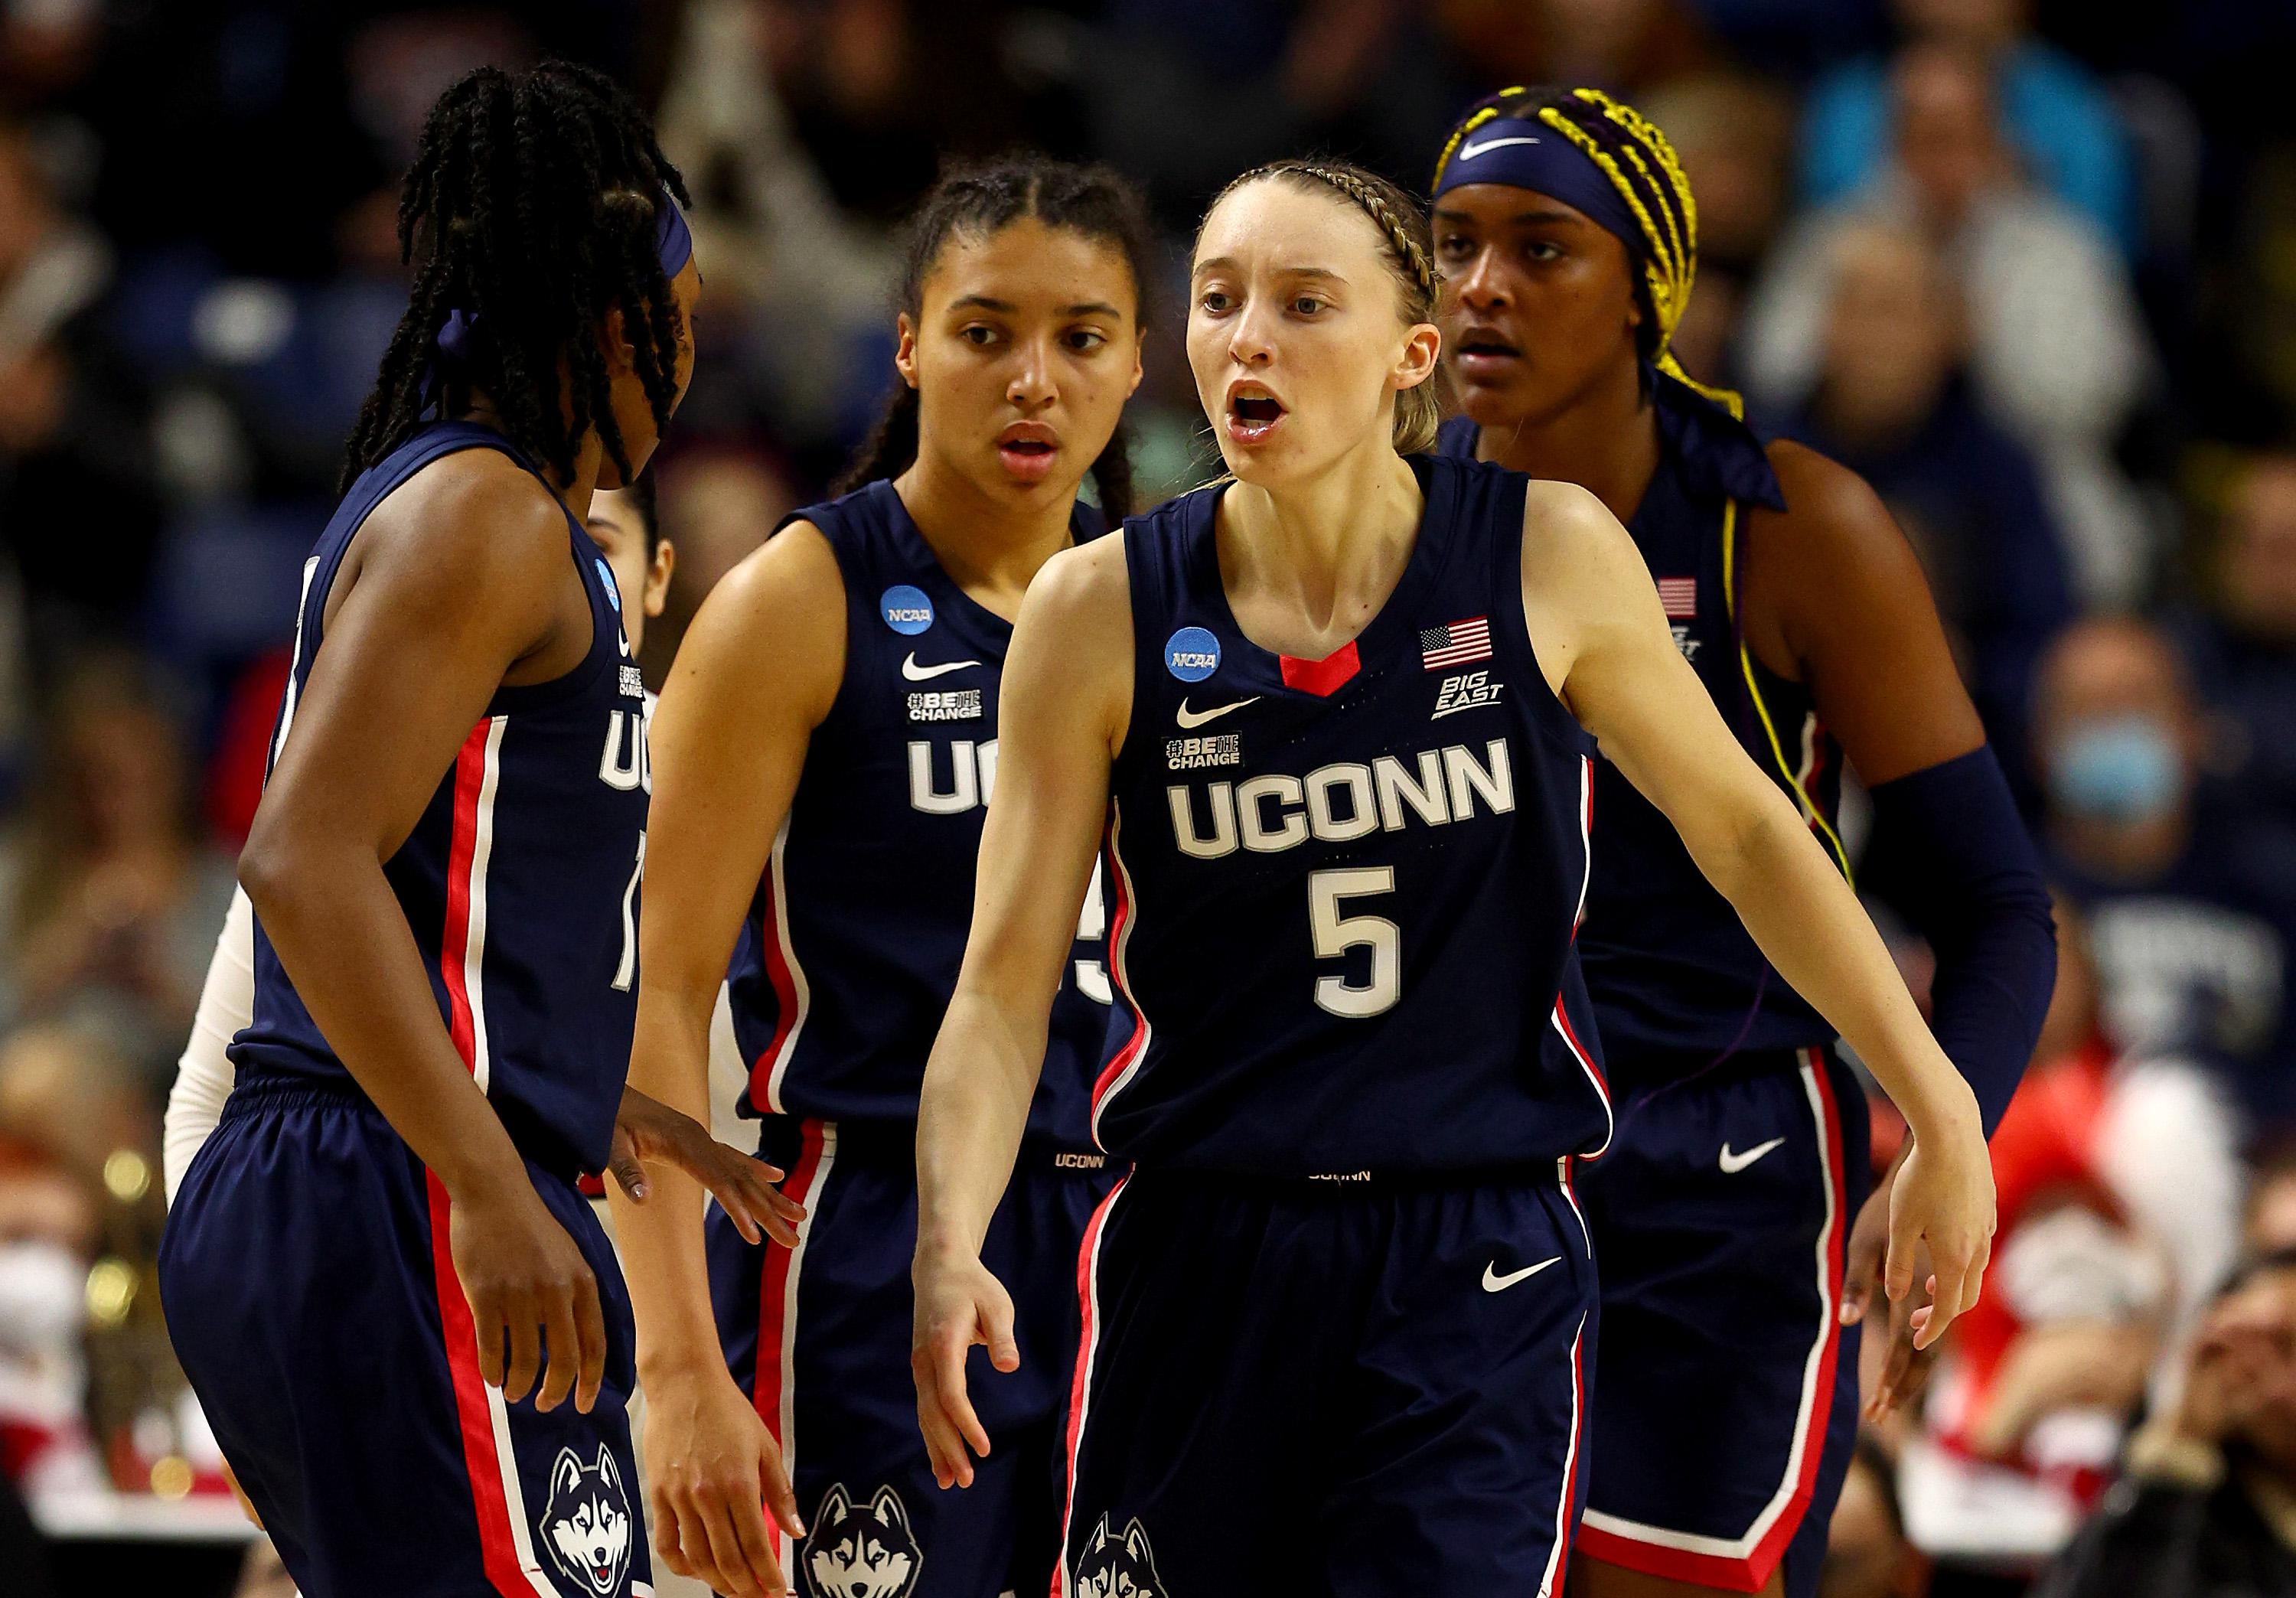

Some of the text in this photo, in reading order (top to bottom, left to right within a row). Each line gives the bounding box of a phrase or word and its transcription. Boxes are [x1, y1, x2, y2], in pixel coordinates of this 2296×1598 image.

[888, 608, 932, 622] NCAA
[1172, 653, 1217, 669] NCAA
[1440, 670, 1489, 695] BIG
[1435, 683, 1504, 711] EAST
[909, 705, 983, 721] CHANGE
[1168, 752, 1240, 770] CHANGE
[1166, 738, 1515, 859] UCONN
[1308, 865, 1401, 1019] 5
[1055, 1153, 1105, 1169] UCONN
